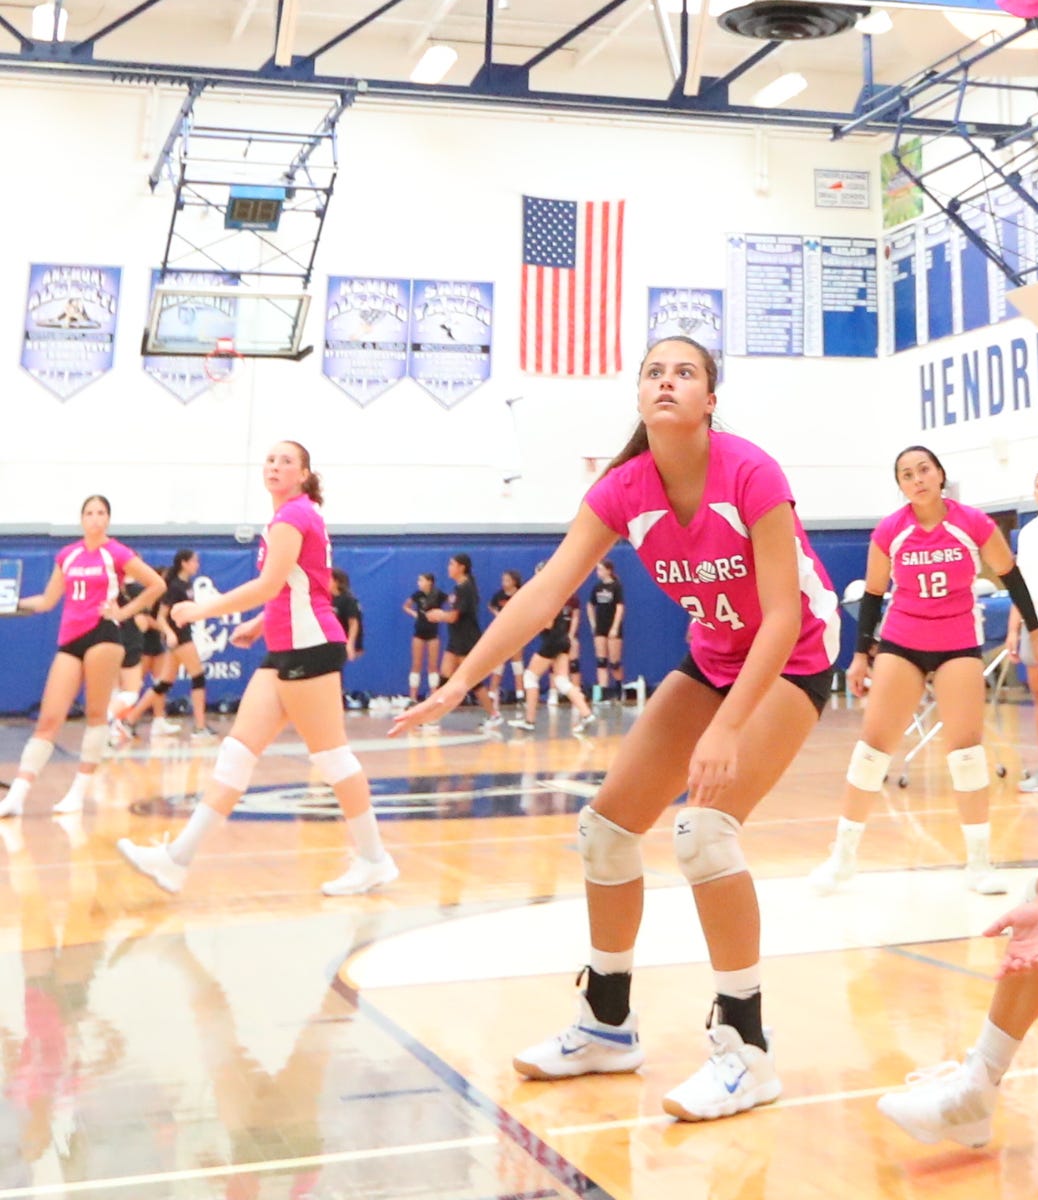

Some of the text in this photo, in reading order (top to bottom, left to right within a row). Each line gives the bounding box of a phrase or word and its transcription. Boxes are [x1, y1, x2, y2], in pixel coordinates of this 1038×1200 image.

[901, 547, 963, 565] SAILORS
[72, 580, 87, 601] 11
[917, 571, 949, 599] 12
[679, 592, 746, 631] 24
